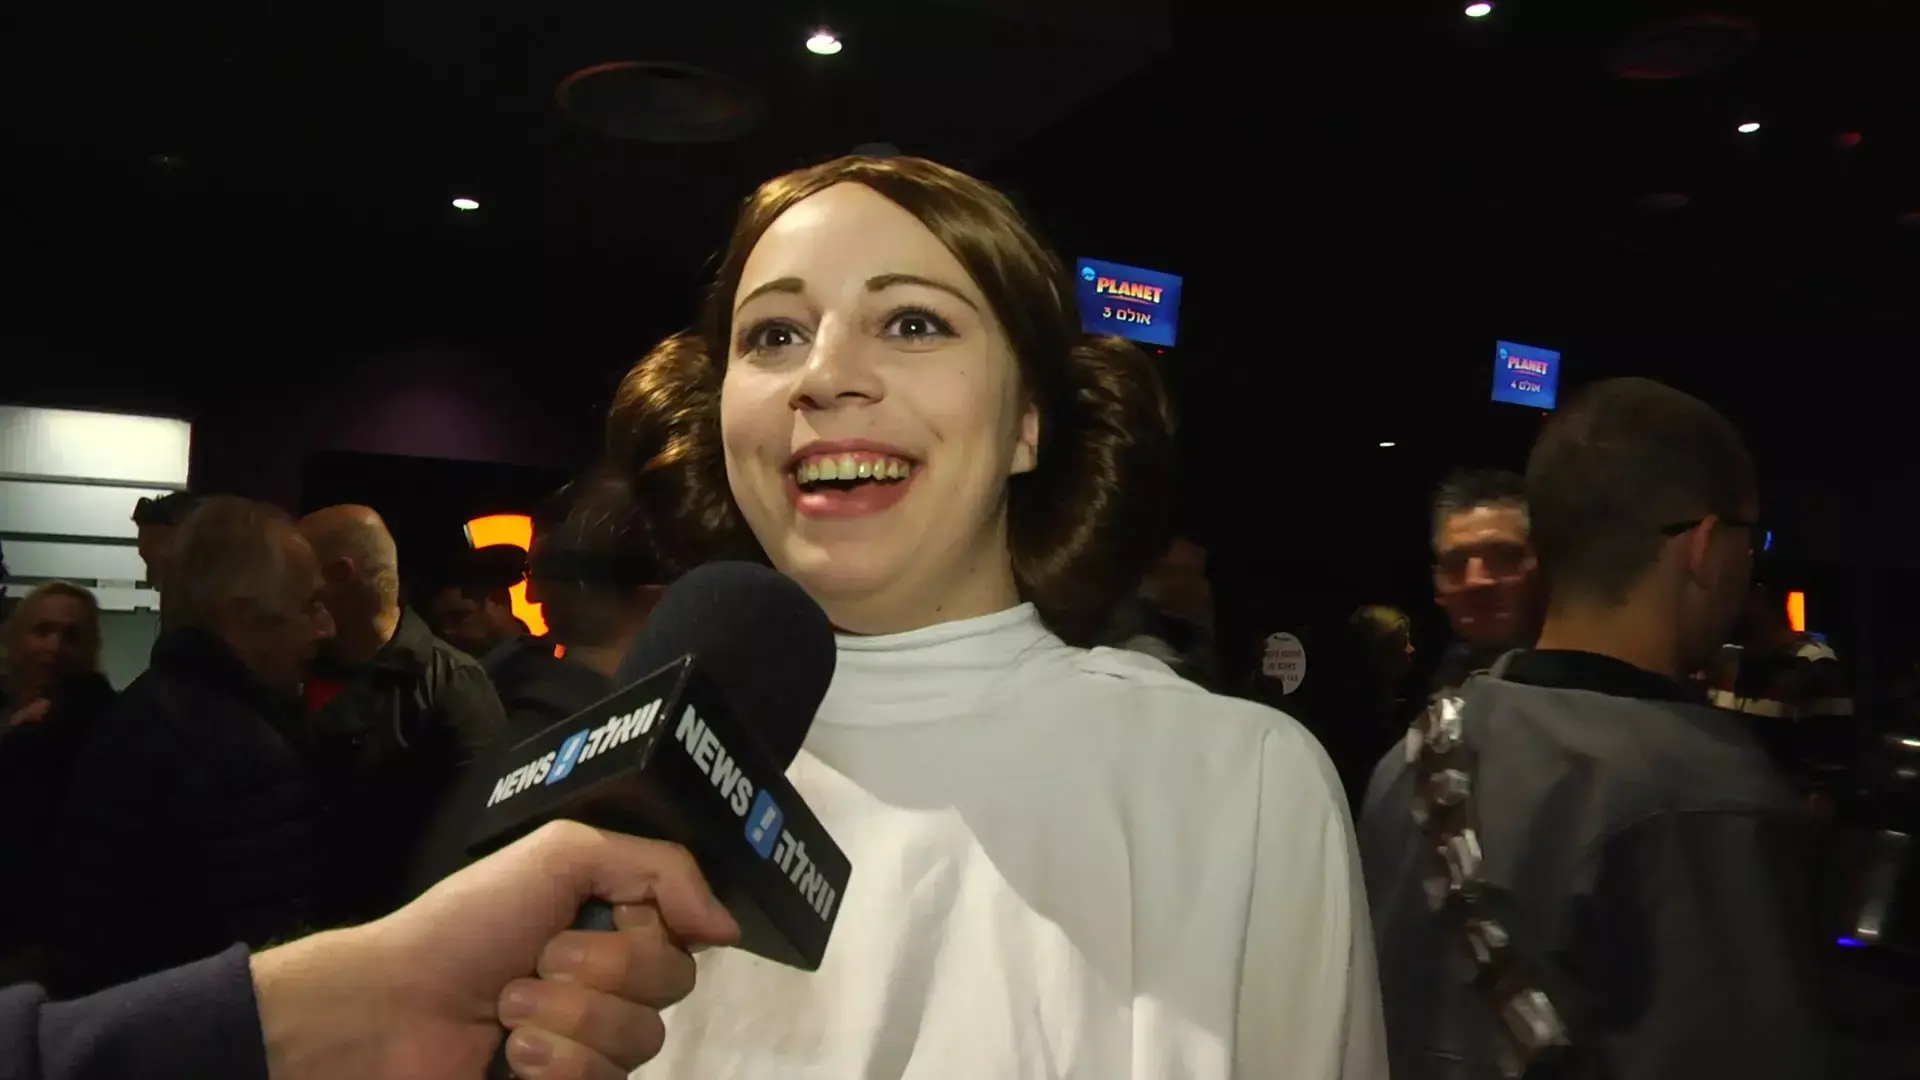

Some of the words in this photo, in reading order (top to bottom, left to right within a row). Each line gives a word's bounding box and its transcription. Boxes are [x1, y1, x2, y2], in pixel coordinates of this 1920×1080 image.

[1096, 276, 1163, 303] PLANET
[1102, 306, 1112, 318] 3
[1116, 307, 1152, 325] אולם
[1507, 356, 1548, 375] PLANET
[674, 703, 753, 818] NEWS
[486, 750, 556, 808] NEWS
